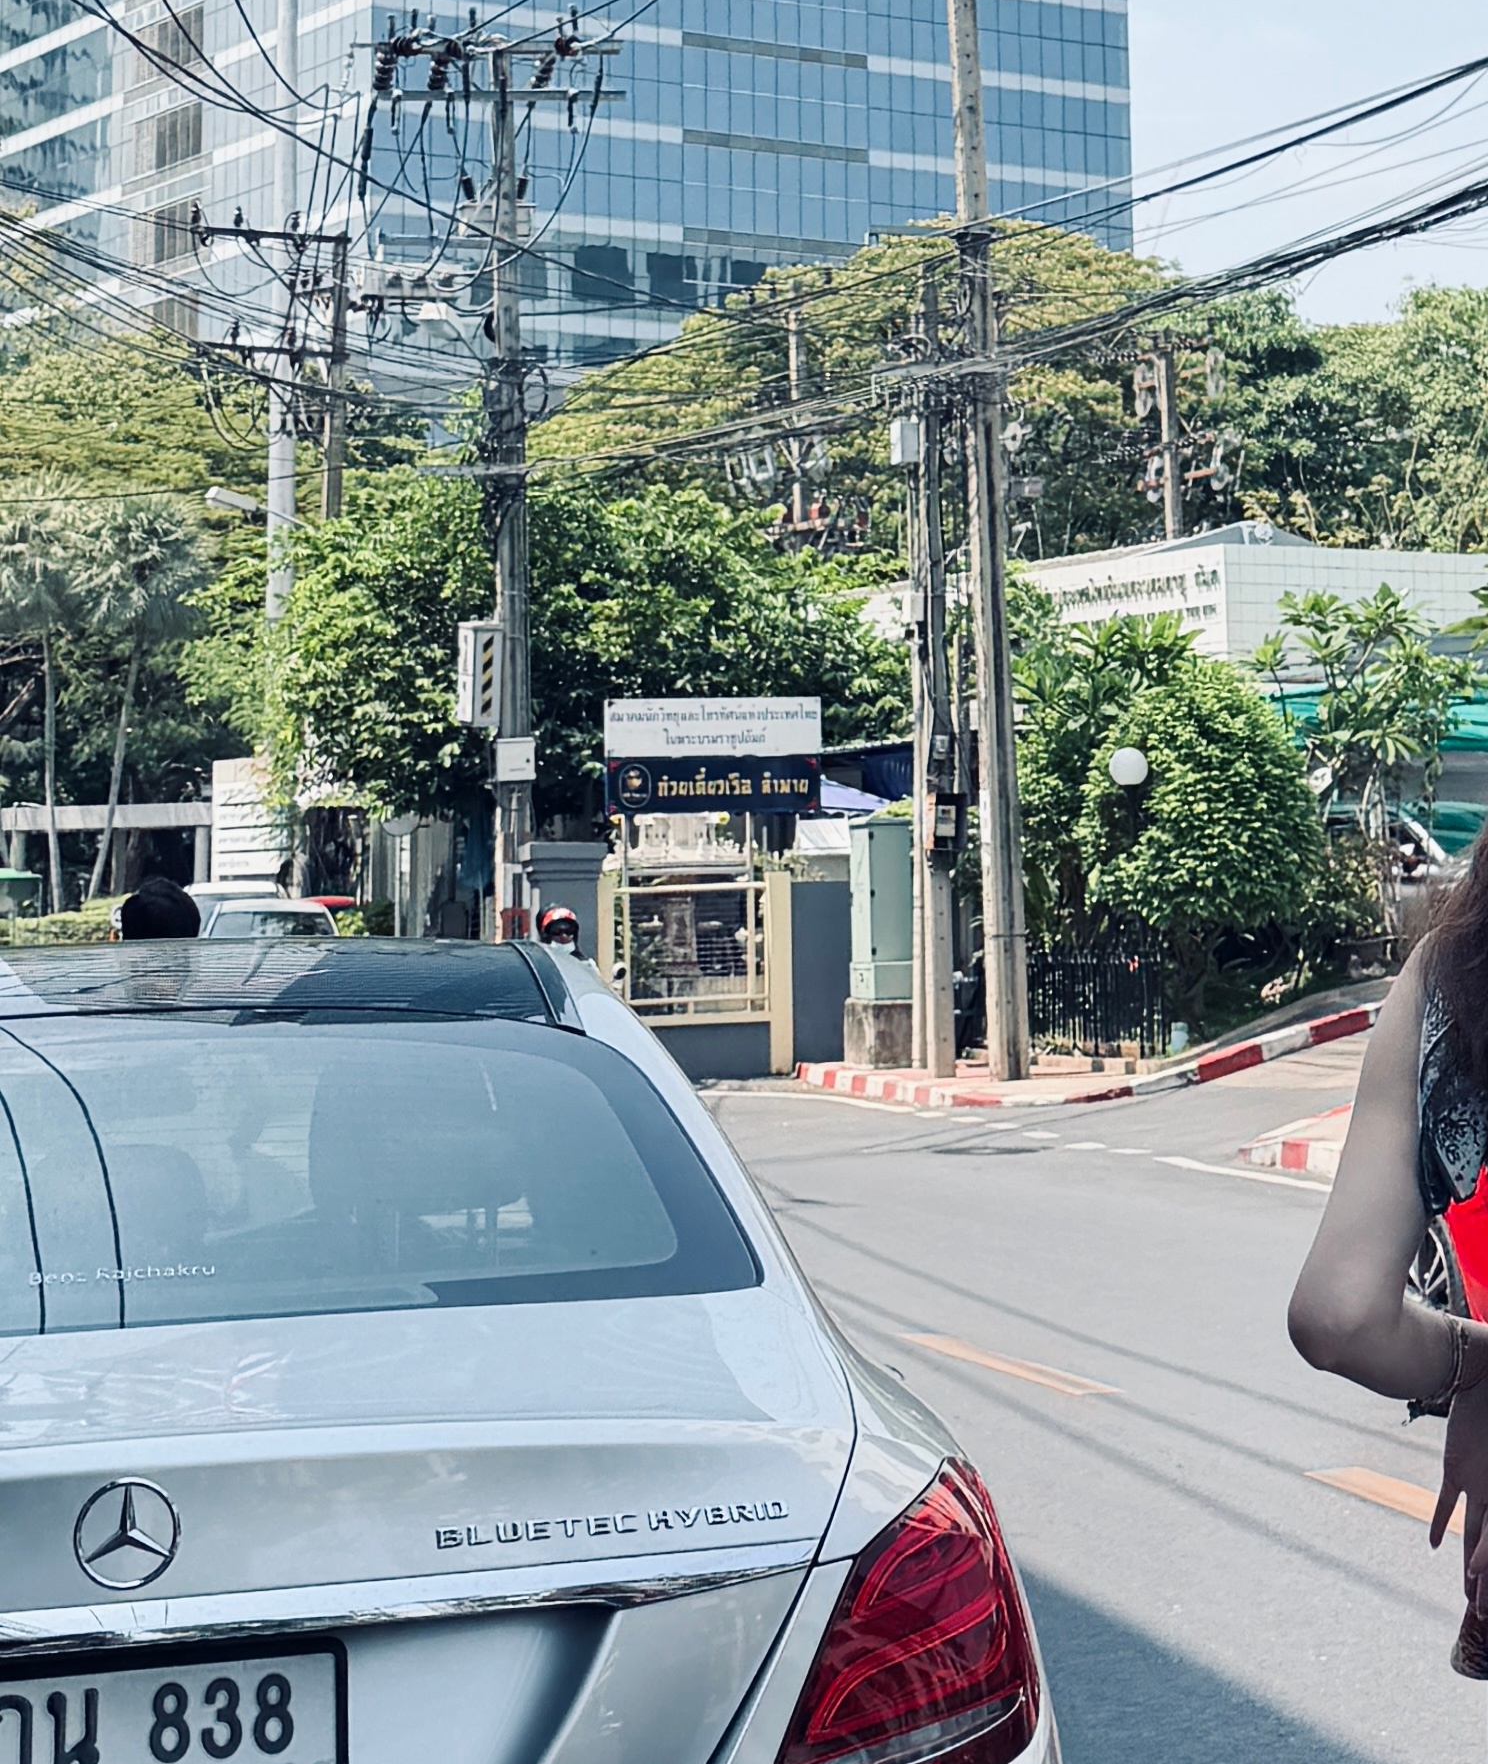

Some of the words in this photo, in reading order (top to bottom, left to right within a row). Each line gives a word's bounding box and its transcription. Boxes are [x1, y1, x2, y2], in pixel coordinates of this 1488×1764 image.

[434, 1512, 638, 1550] BLUETEC
[646, 1499, 789, 1532] HYBRID
[148, 1672, 294, 1764] 838
